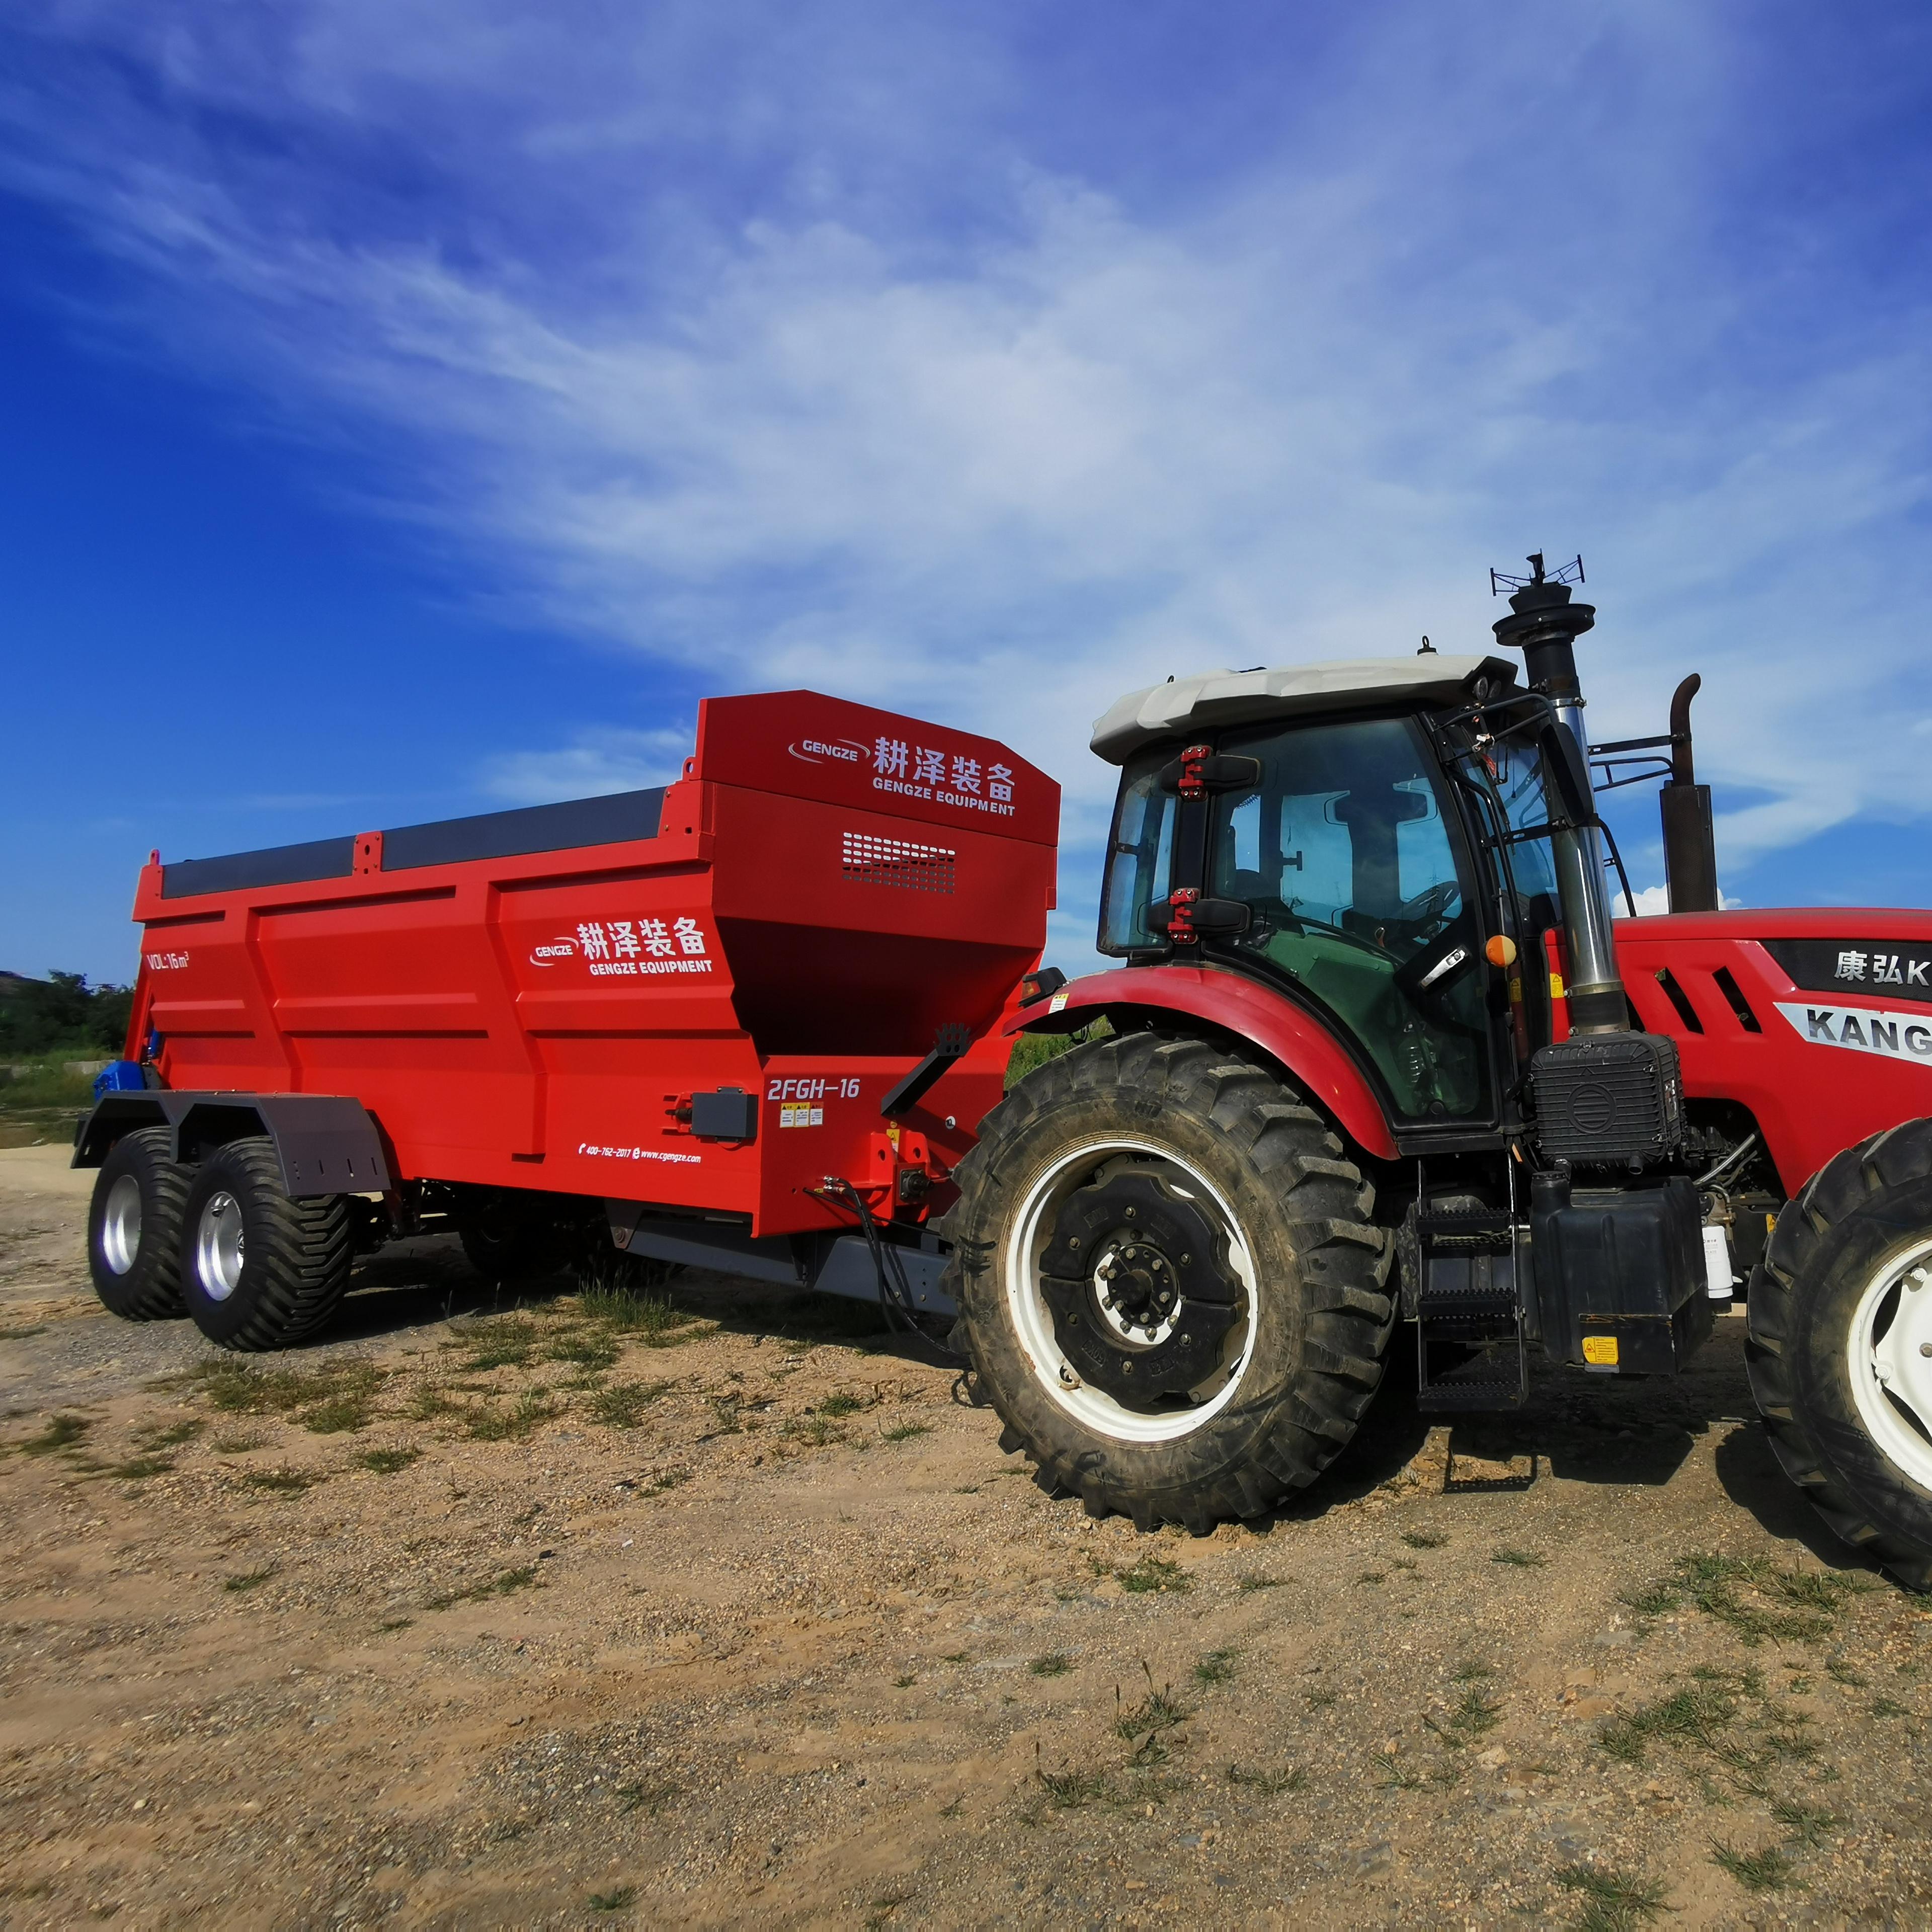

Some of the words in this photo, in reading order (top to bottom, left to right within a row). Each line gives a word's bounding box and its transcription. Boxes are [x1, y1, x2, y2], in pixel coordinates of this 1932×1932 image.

[802, 740, 858, 762] GENGZE
[873, 737, 1015, 802] 耕泽装备
[873, 777, 931, 799] GENGZE
[936, 790, 1015, 817] EQUIPMENT
[577, 917, 705, 960] 耕泽装备
[535, 944, 574, 957] GENGZE
[590, 962, 637, 976] GENGZE
[639, 959, 712, 975] EQUIPMENT
[1807, 1008, 1932, 1056] KANG
[768, 1078, 860, 1100] 2FGH-16
[586, 1146, 631, 1158] 400-762-2017
[641, 1151, 701, 1163] www.cgengze.com
